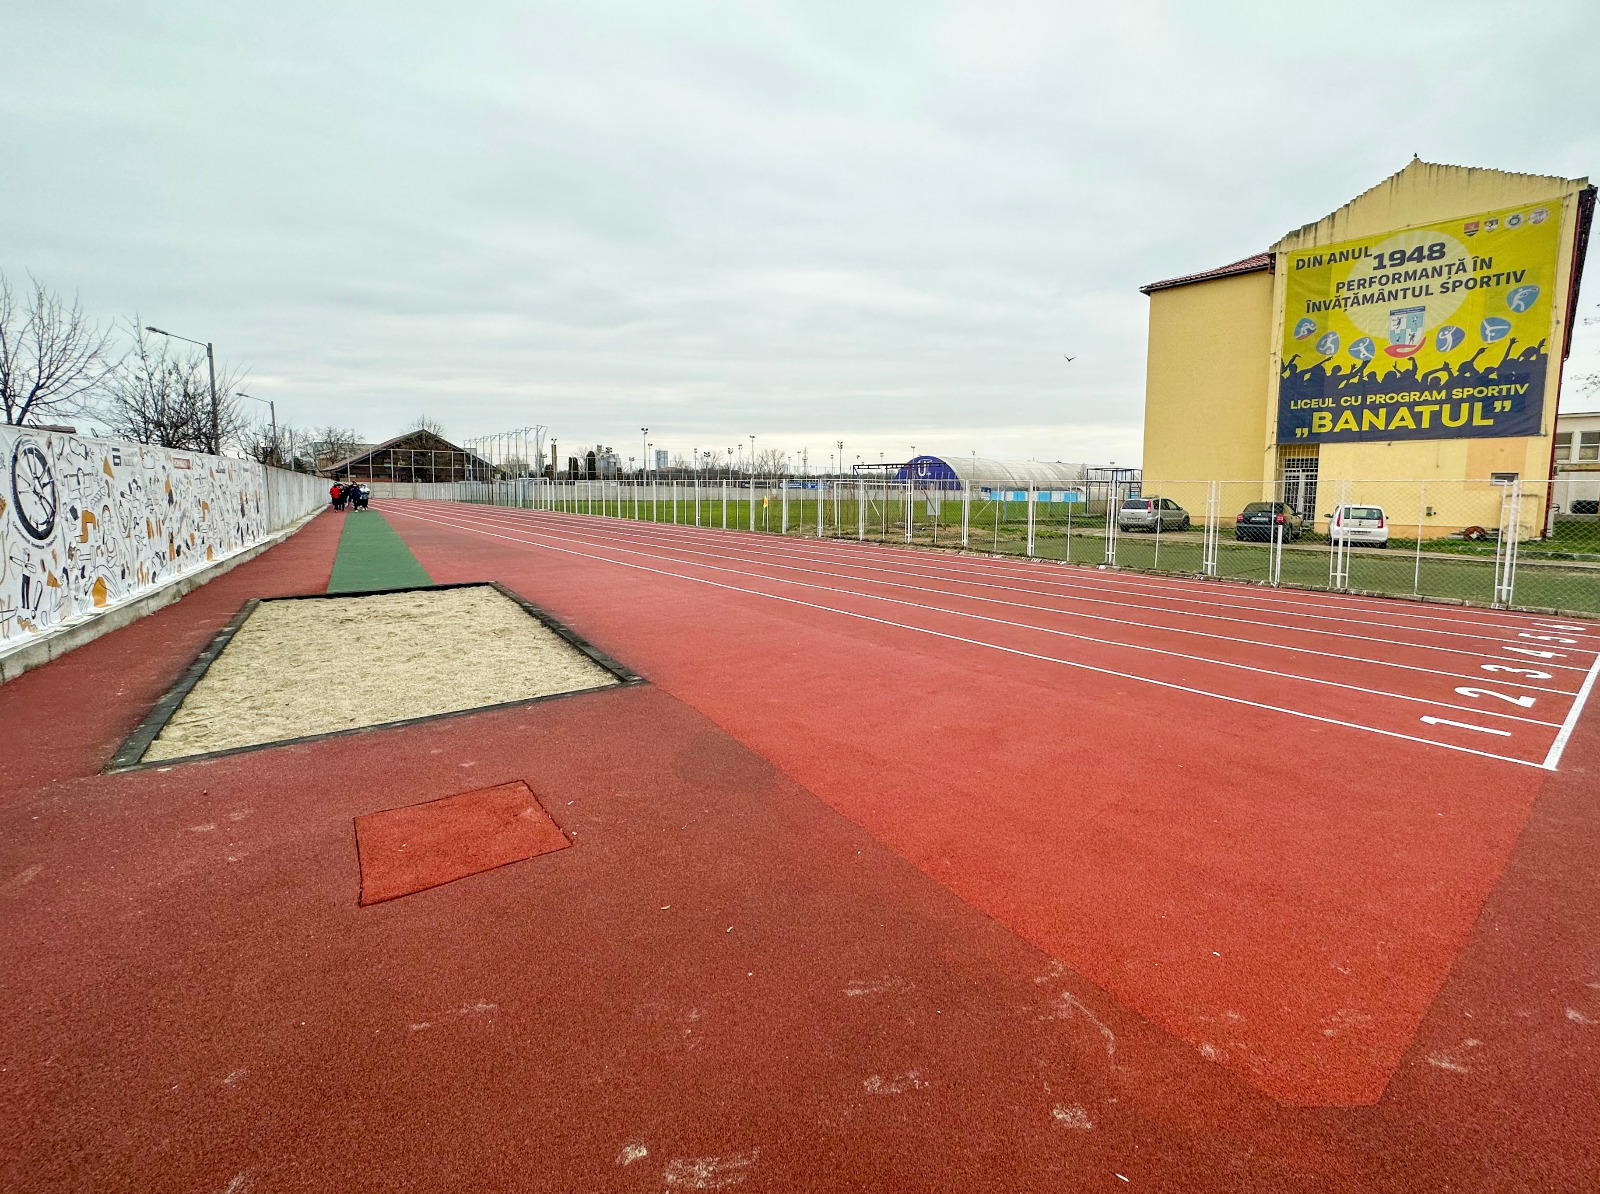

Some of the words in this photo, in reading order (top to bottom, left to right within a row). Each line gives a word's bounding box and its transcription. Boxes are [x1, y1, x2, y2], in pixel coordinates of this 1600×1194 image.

[1295, 255, 1323, 271] DIN
[1327, 246, 1373, 265] ANUL
[1373, 242, 1446, 271] 1948
[1472, 255, 1493, 272] ÎN
[1440, 269, 1526, 294] SPORTIV
[1290, 397, 1336, 410] LICEUL
[1340, 395, 1362, 407] CU
[1366, 389, 1446, 405] PROGRAM
[1451, 383, 1529, 399] SPORTIV
[1518, 632, 1578, 644] 5
[1501, 646, 1568, 659] 4
[1480, 664, 1552, 680] 3
[1454, 686, 1537, 708] 2
[1419, 715, 1512, 737] 1
